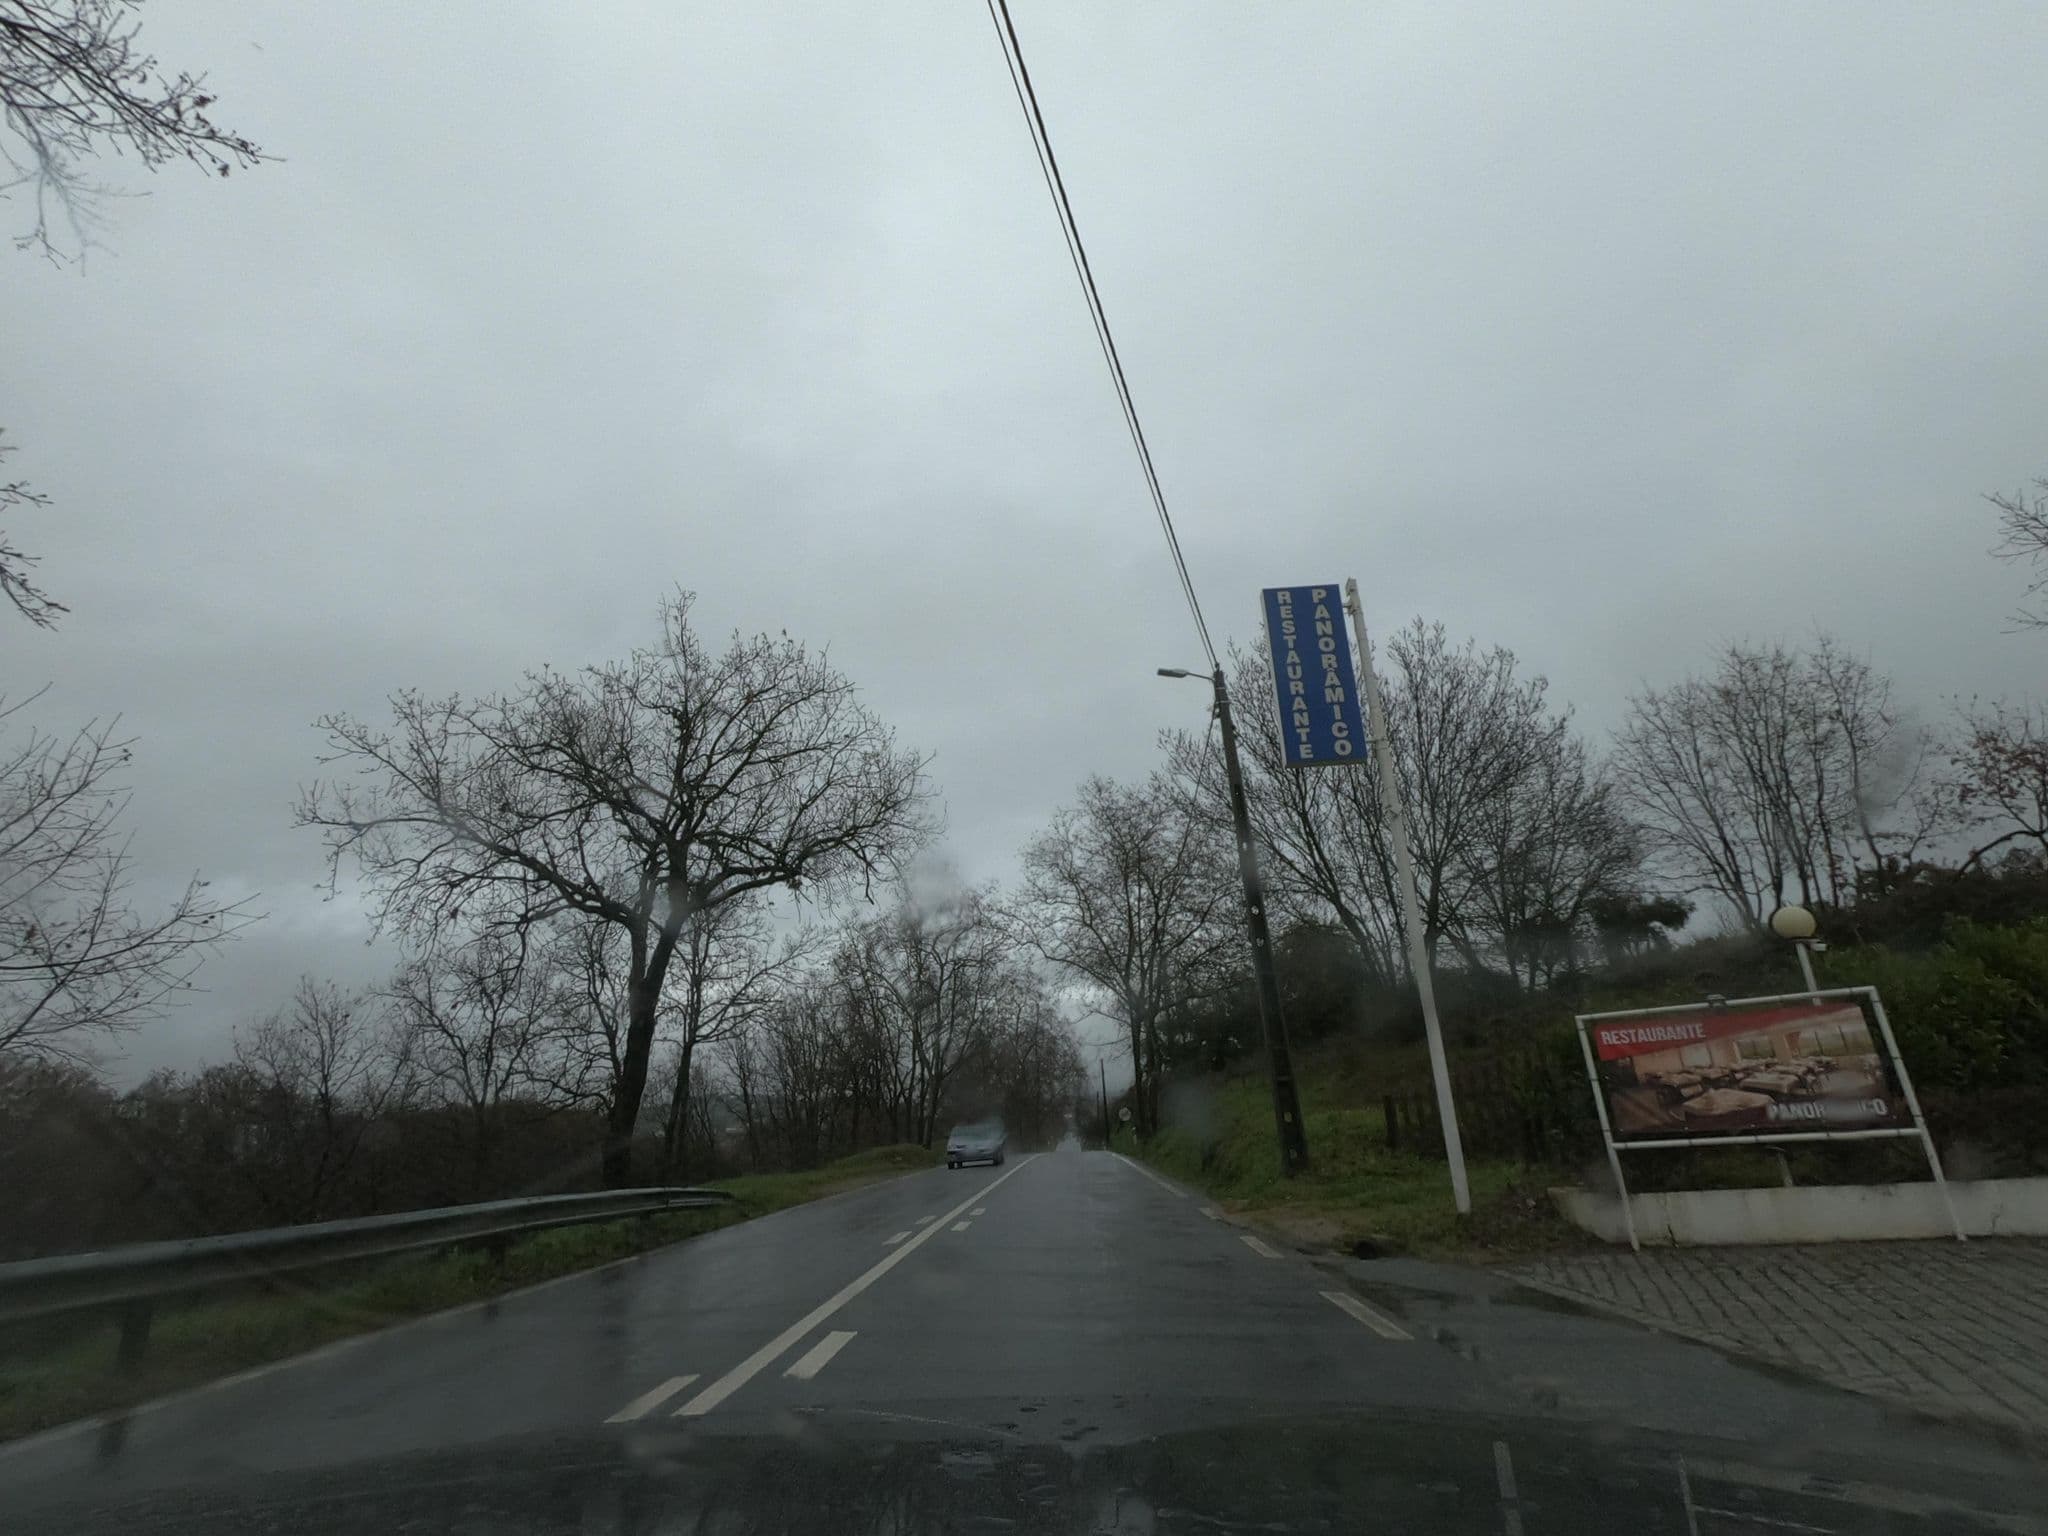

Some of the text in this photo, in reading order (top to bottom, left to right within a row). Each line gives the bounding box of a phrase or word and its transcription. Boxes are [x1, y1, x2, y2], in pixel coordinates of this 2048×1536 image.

[1277, 591, 1314, 759] RESTAURANTE
[1600, 1023, 1706, 1045] RESTAURANTE
[1767, 1098, 1888, 1120] PANORICO
